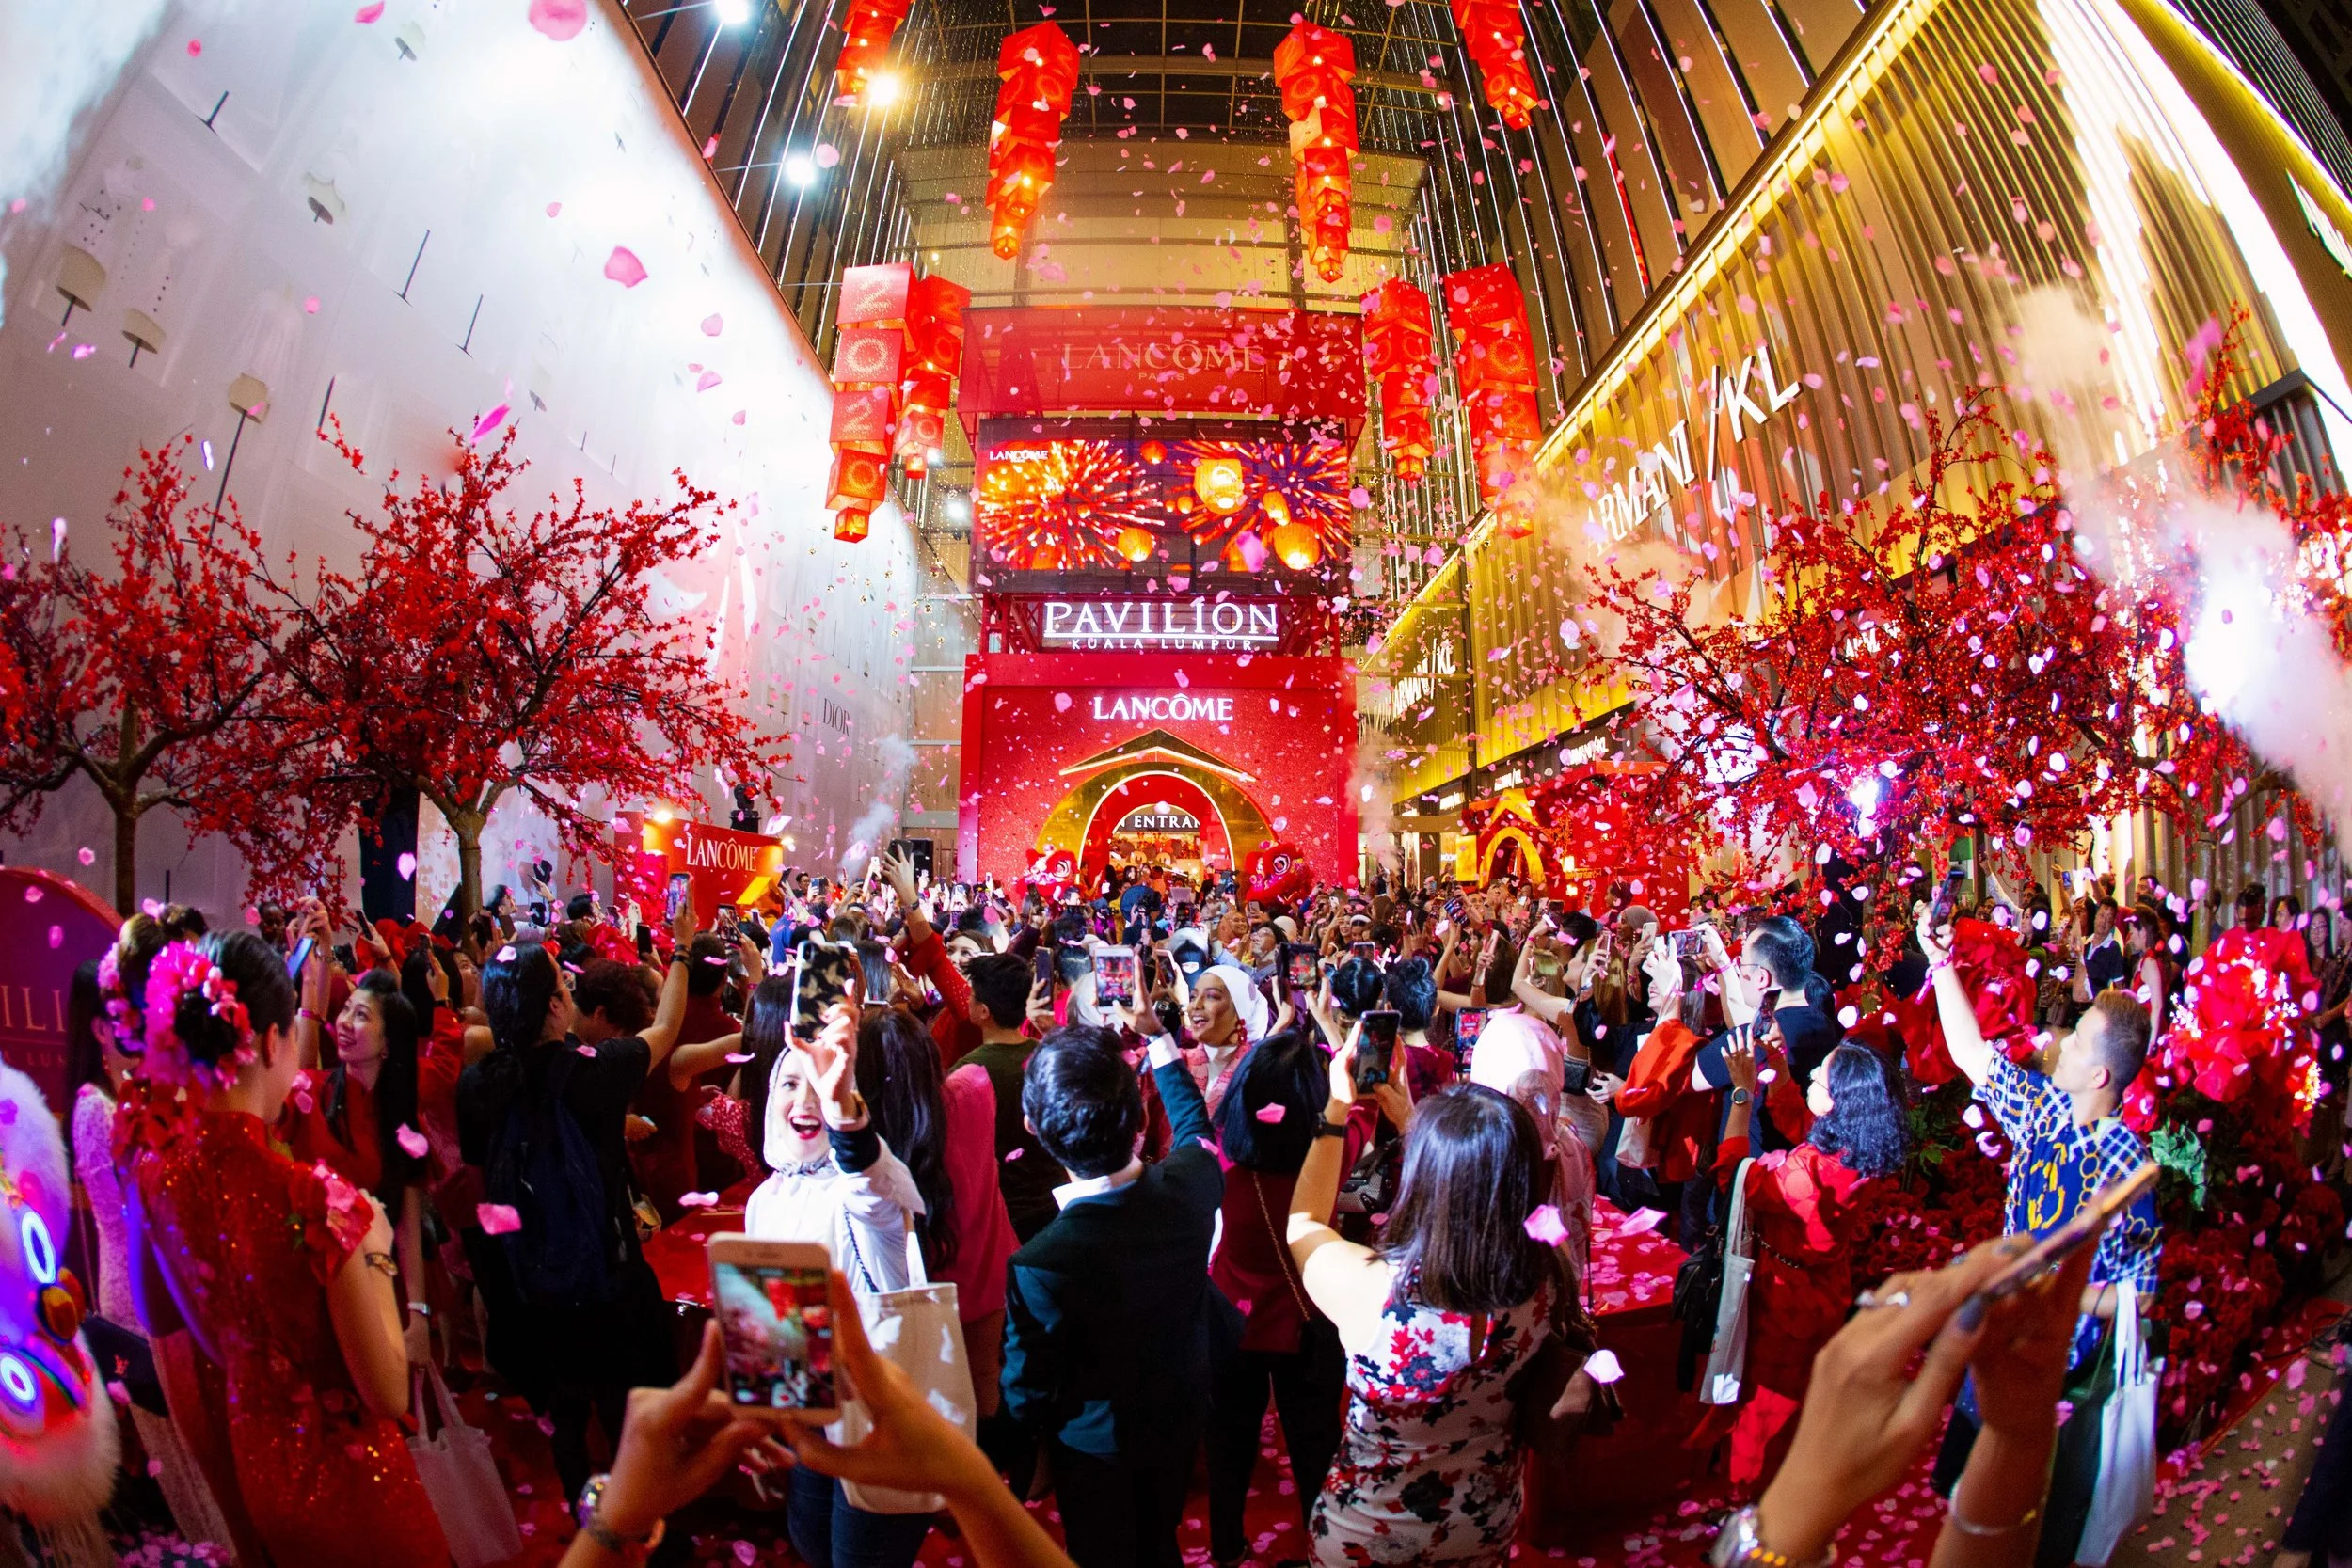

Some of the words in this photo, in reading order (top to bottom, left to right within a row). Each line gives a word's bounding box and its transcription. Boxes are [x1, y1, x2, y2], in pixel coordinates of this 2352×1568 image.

[1138, 372, 1185, 382] PAS
[1043, 600, 1279, 635] PAVILION
[1071, 637, 1144, 651] KUALA
[1161, 638, 1253, 652] LUMPUR
[823, 698, 850, 738] DIOR
[1092, 692, 1234, 721] LANCÔME
[686, 835, 757, 873] LANCÔME
